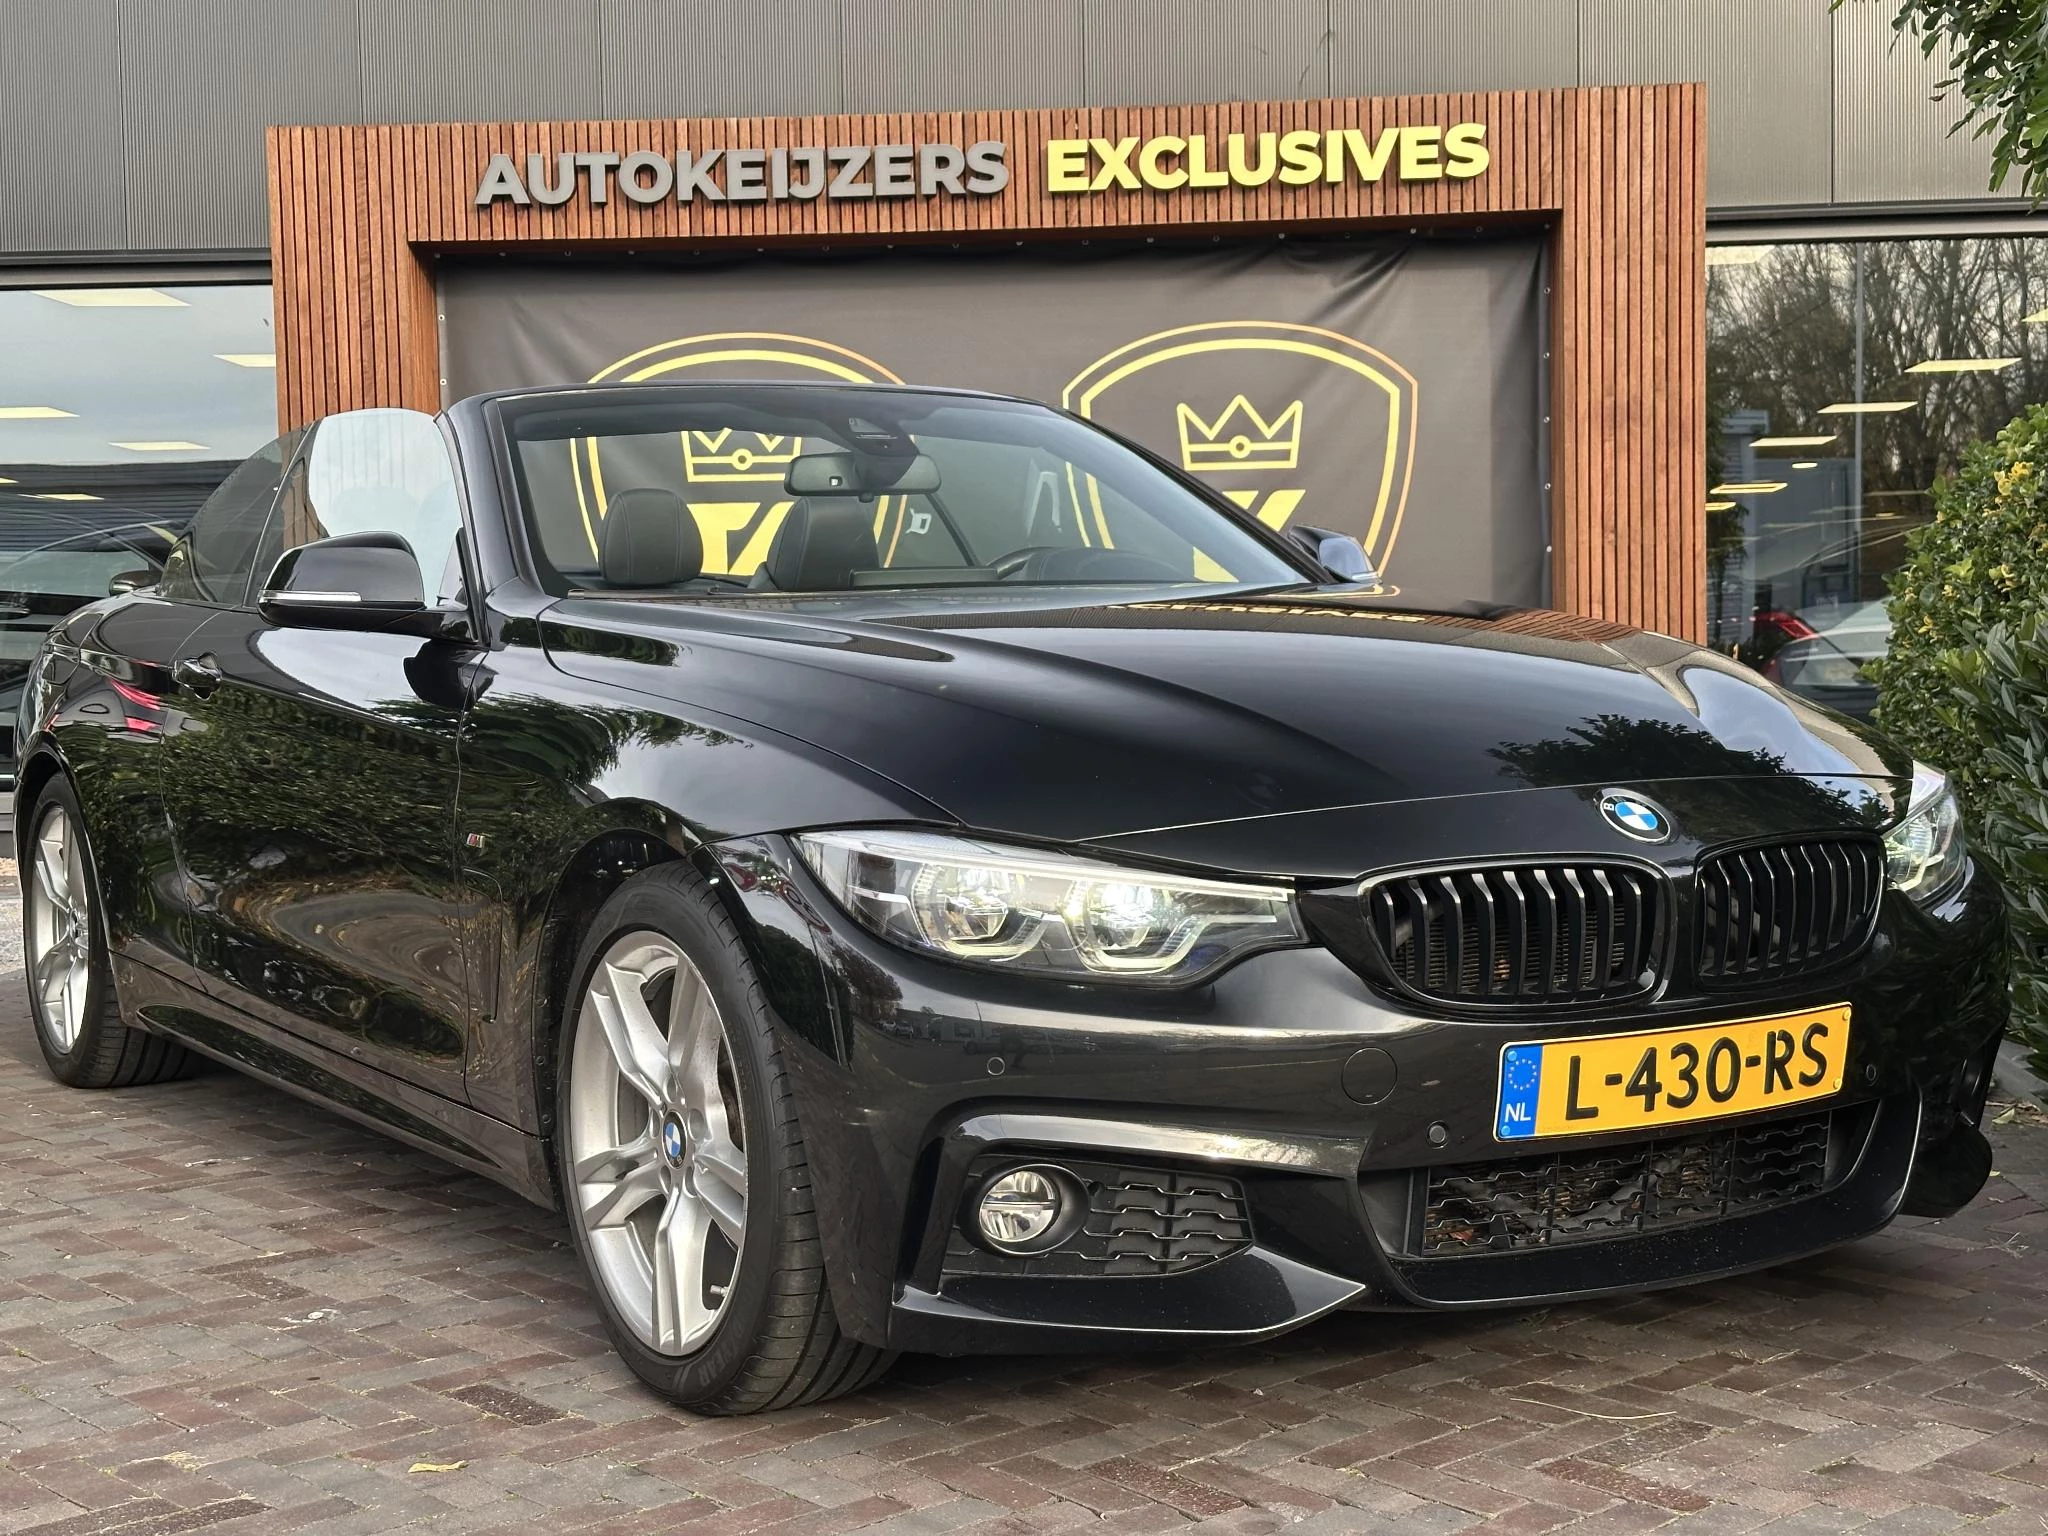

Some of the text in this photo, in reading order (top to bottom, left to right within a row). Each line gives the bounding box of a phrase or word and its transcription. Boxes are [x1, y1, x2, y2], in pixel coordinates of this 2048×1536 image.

[475, 122, 1490, 206] AUTOKEIJZERS EXCLUSIVES
[1504, 1102, 1531, 1122] NL
[1565, 1022, 1828, 1120] L-430-RS
